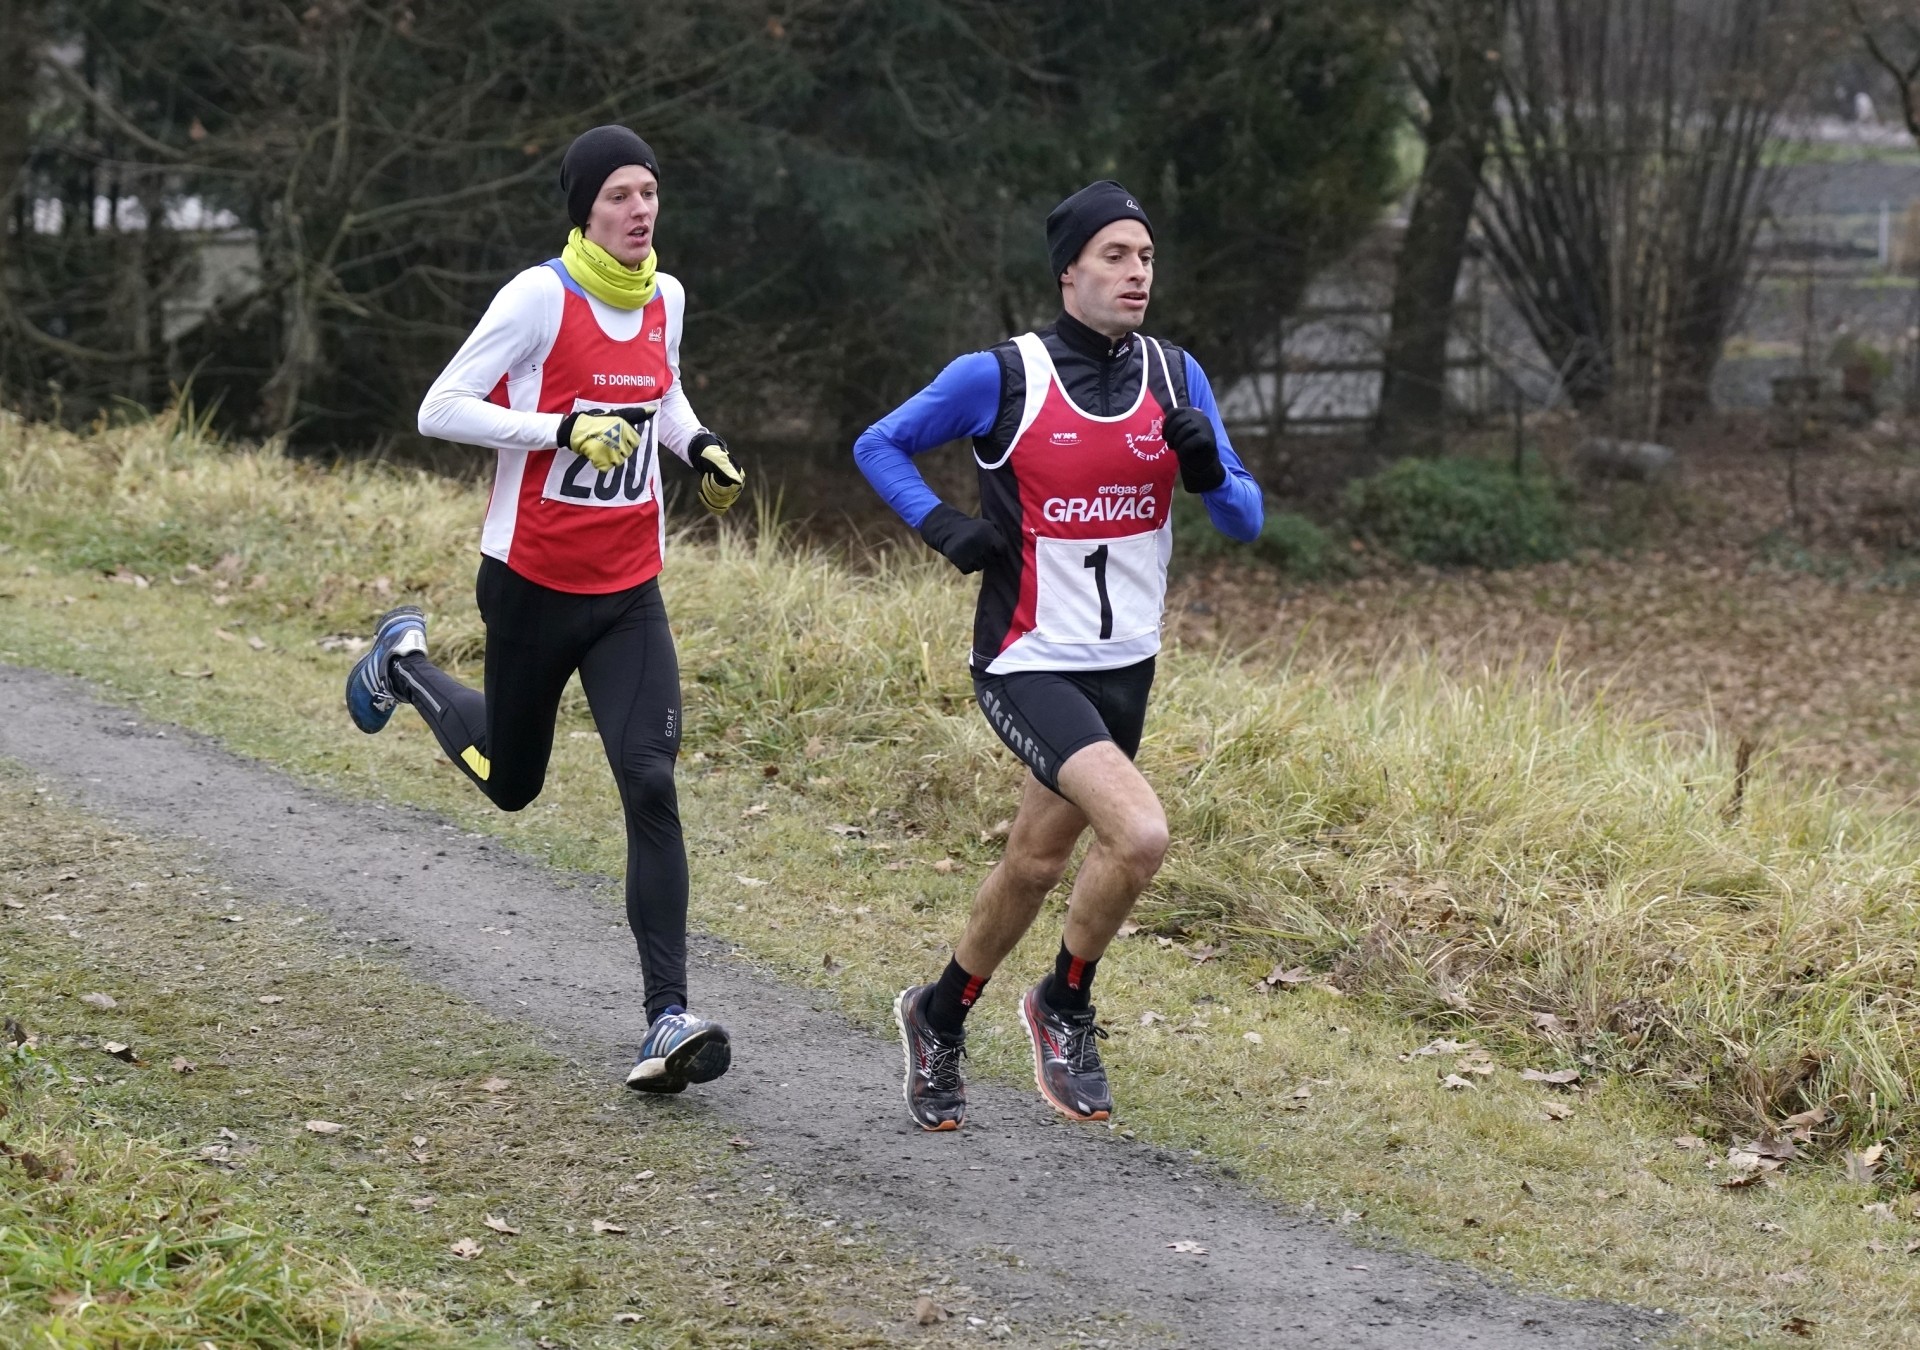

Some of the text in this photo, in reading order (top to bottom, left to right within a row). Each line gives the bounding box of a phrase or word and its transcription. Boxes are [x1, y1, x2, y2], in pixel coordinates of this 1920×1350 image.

[592, 374, 656, 387] TS DORNBIRN
[1098, 484, 1137, 496] erdgas
[1043, 496, 1156, 522] GRAVAG
[1083, 544, 1113, 640] 1
[665, 707, 675, 737] GORE
[982, 690, 1047, 775] skinfit
